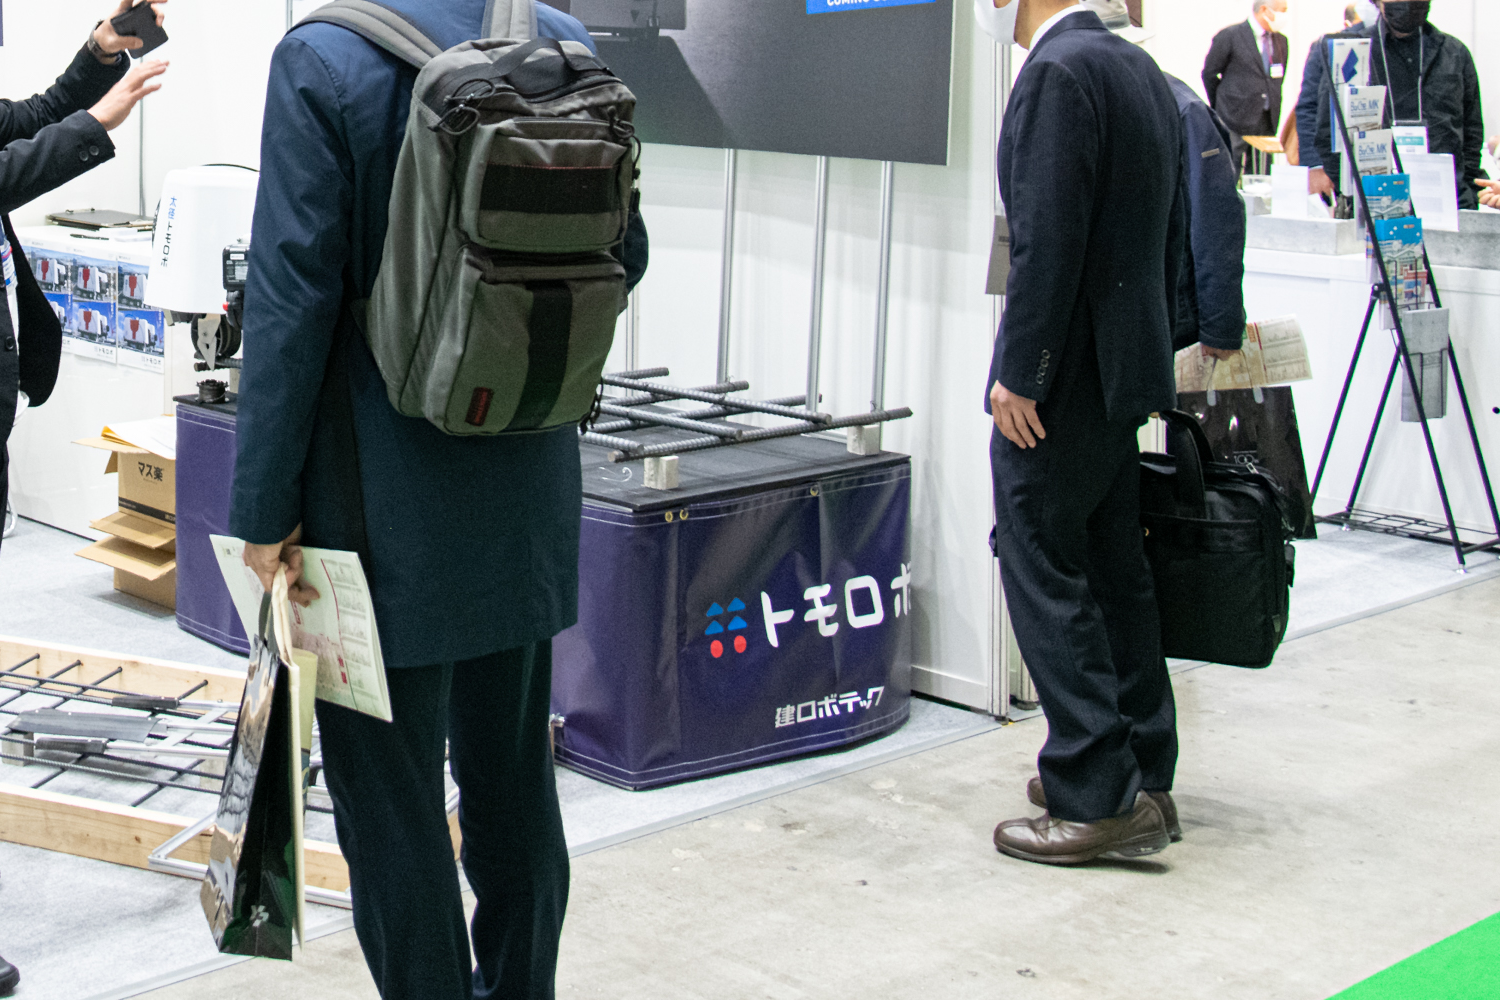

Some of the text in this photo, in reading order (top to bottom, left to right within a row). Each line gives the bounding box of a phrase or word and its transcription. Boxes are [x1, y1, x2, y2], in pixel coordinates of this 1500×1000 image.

[137, 461, 163, 482] マス楽
[760, 560, 911, 648] トモロボ
[774, 686, 885, 729] 建ロボテック
